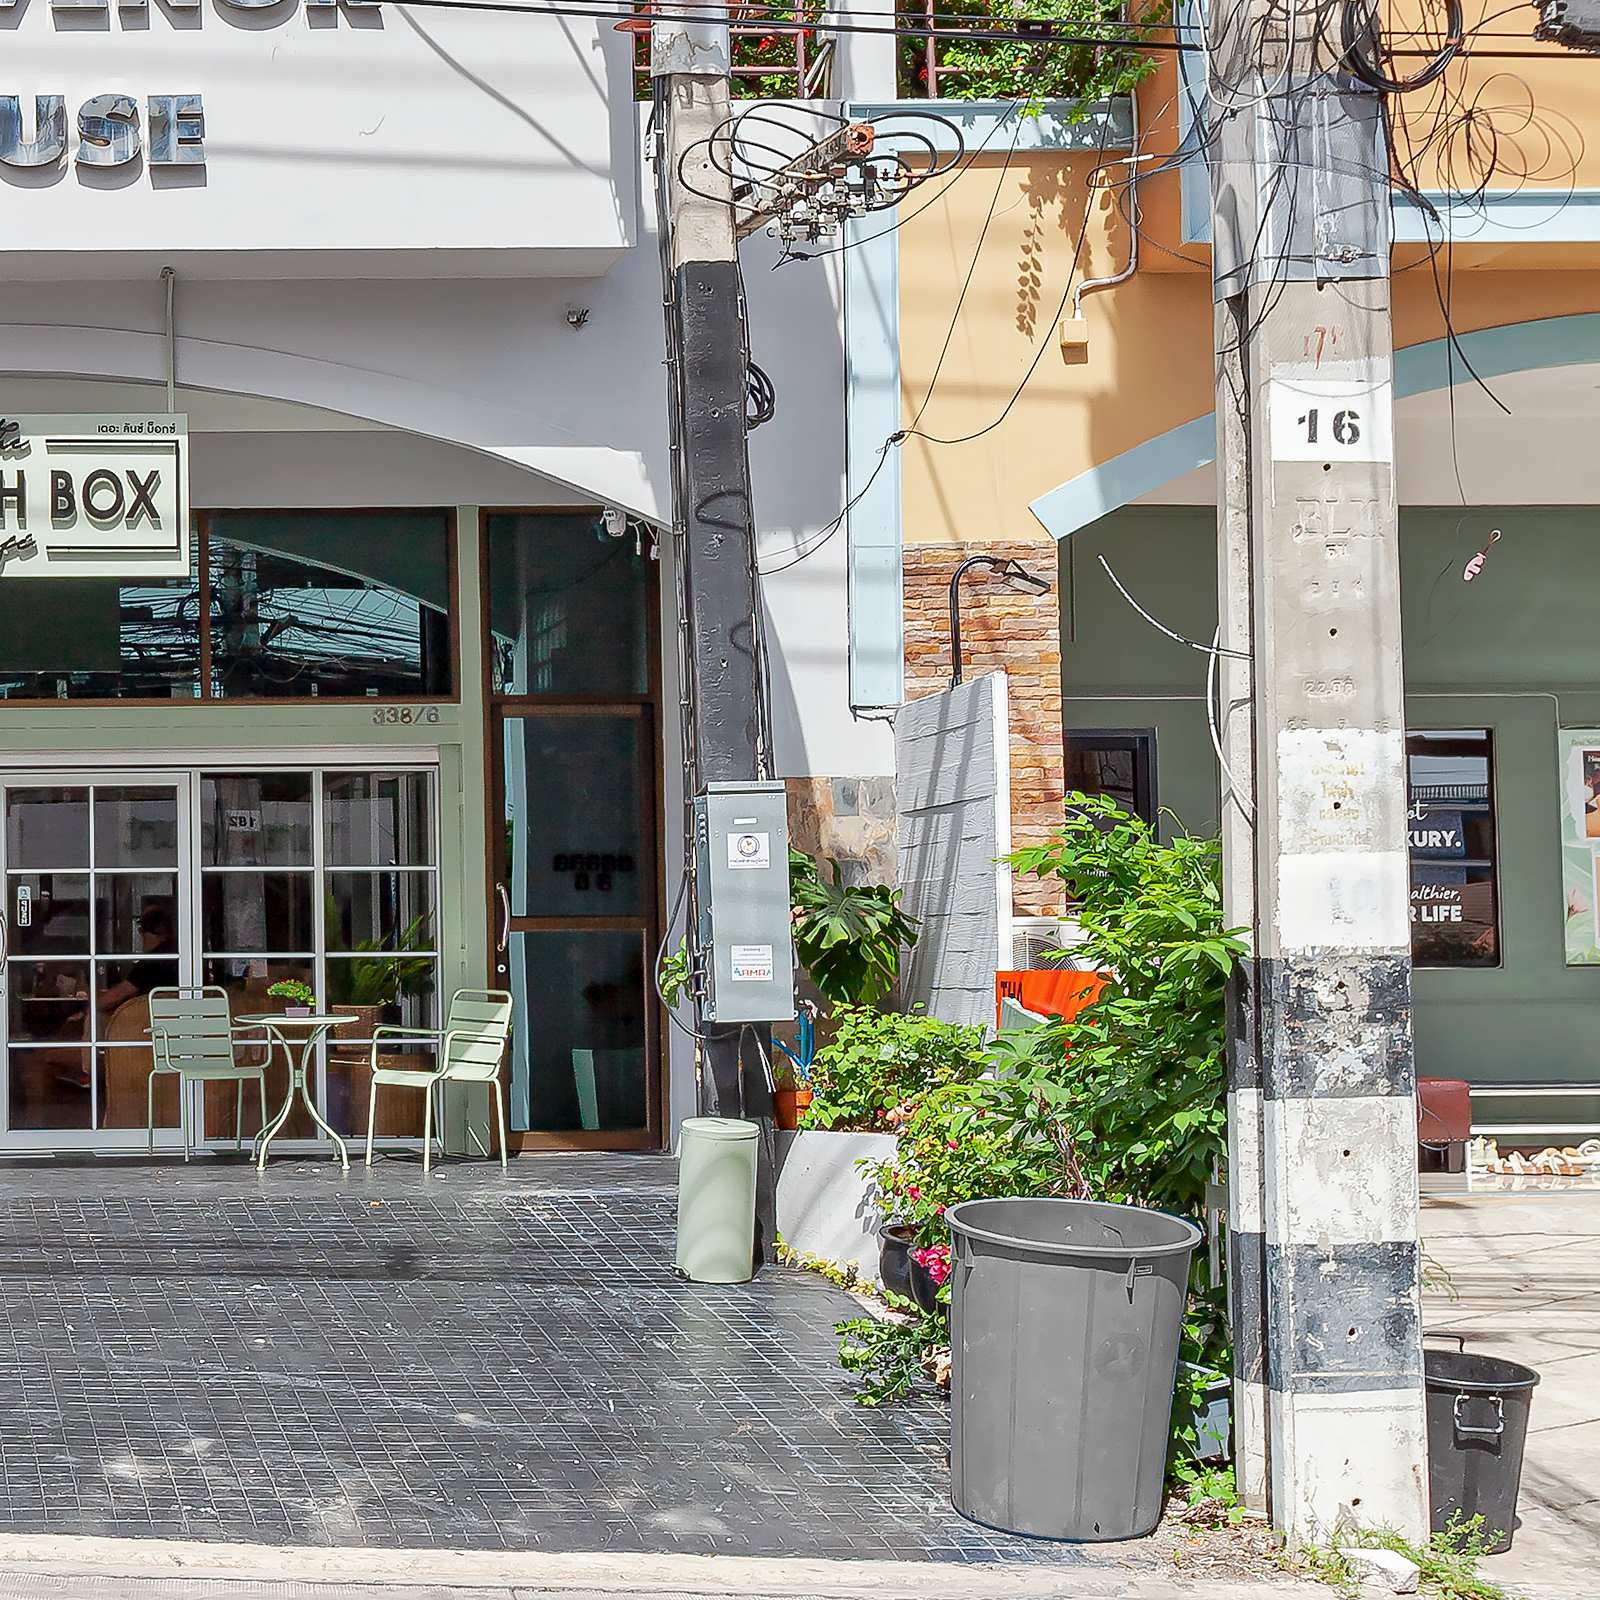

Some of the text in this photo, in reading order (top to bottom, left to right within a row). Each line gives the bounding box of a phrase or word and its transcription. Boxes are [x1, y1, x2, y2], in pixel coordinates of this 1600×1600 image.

[1297, 409, 1360, 445] 16
[50, 469, 160, 521] BOX
[372, 706, 440, 725] 338/6
[1421, 905, 1463, 922] LIFE
